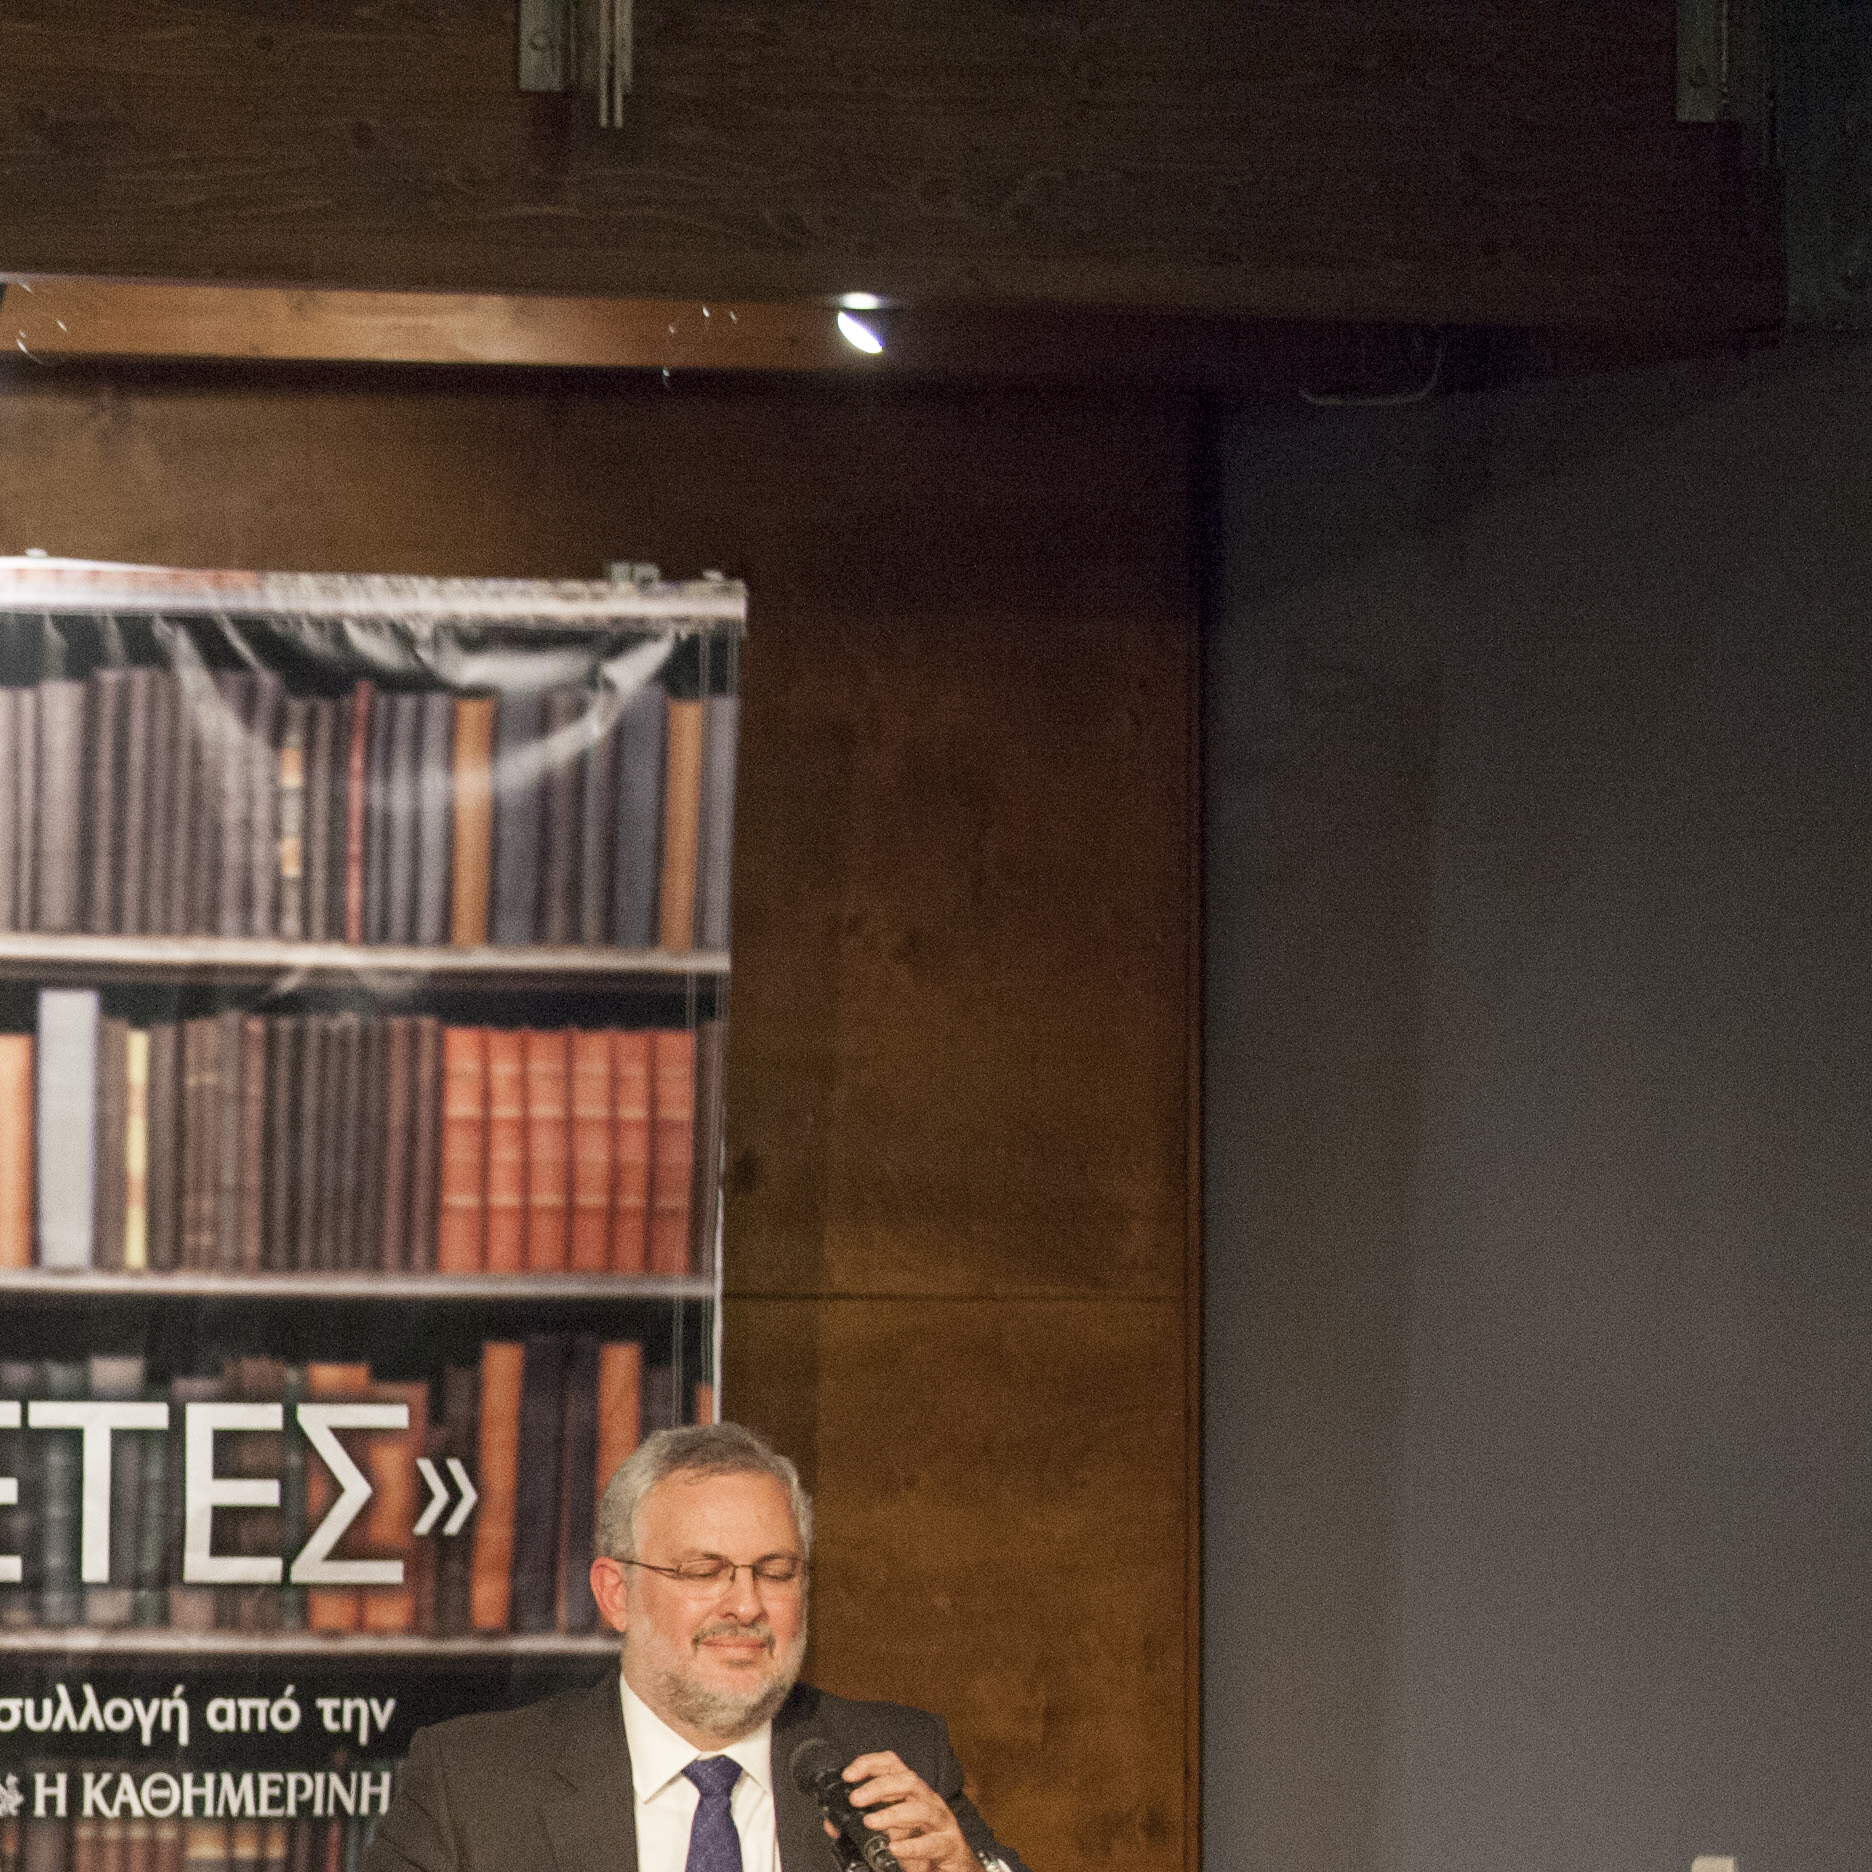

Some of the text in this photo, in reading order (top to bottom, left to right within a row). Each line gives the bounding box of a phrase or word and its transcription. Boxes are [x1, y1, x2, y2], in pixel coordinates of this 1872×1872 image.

[205, 1684, 302, 1732] από
[316, 1697, 396, 1746] την
[33, 1771, 392, 1820] Η ΚΑΘΗΜΕΡΙΝΗ
